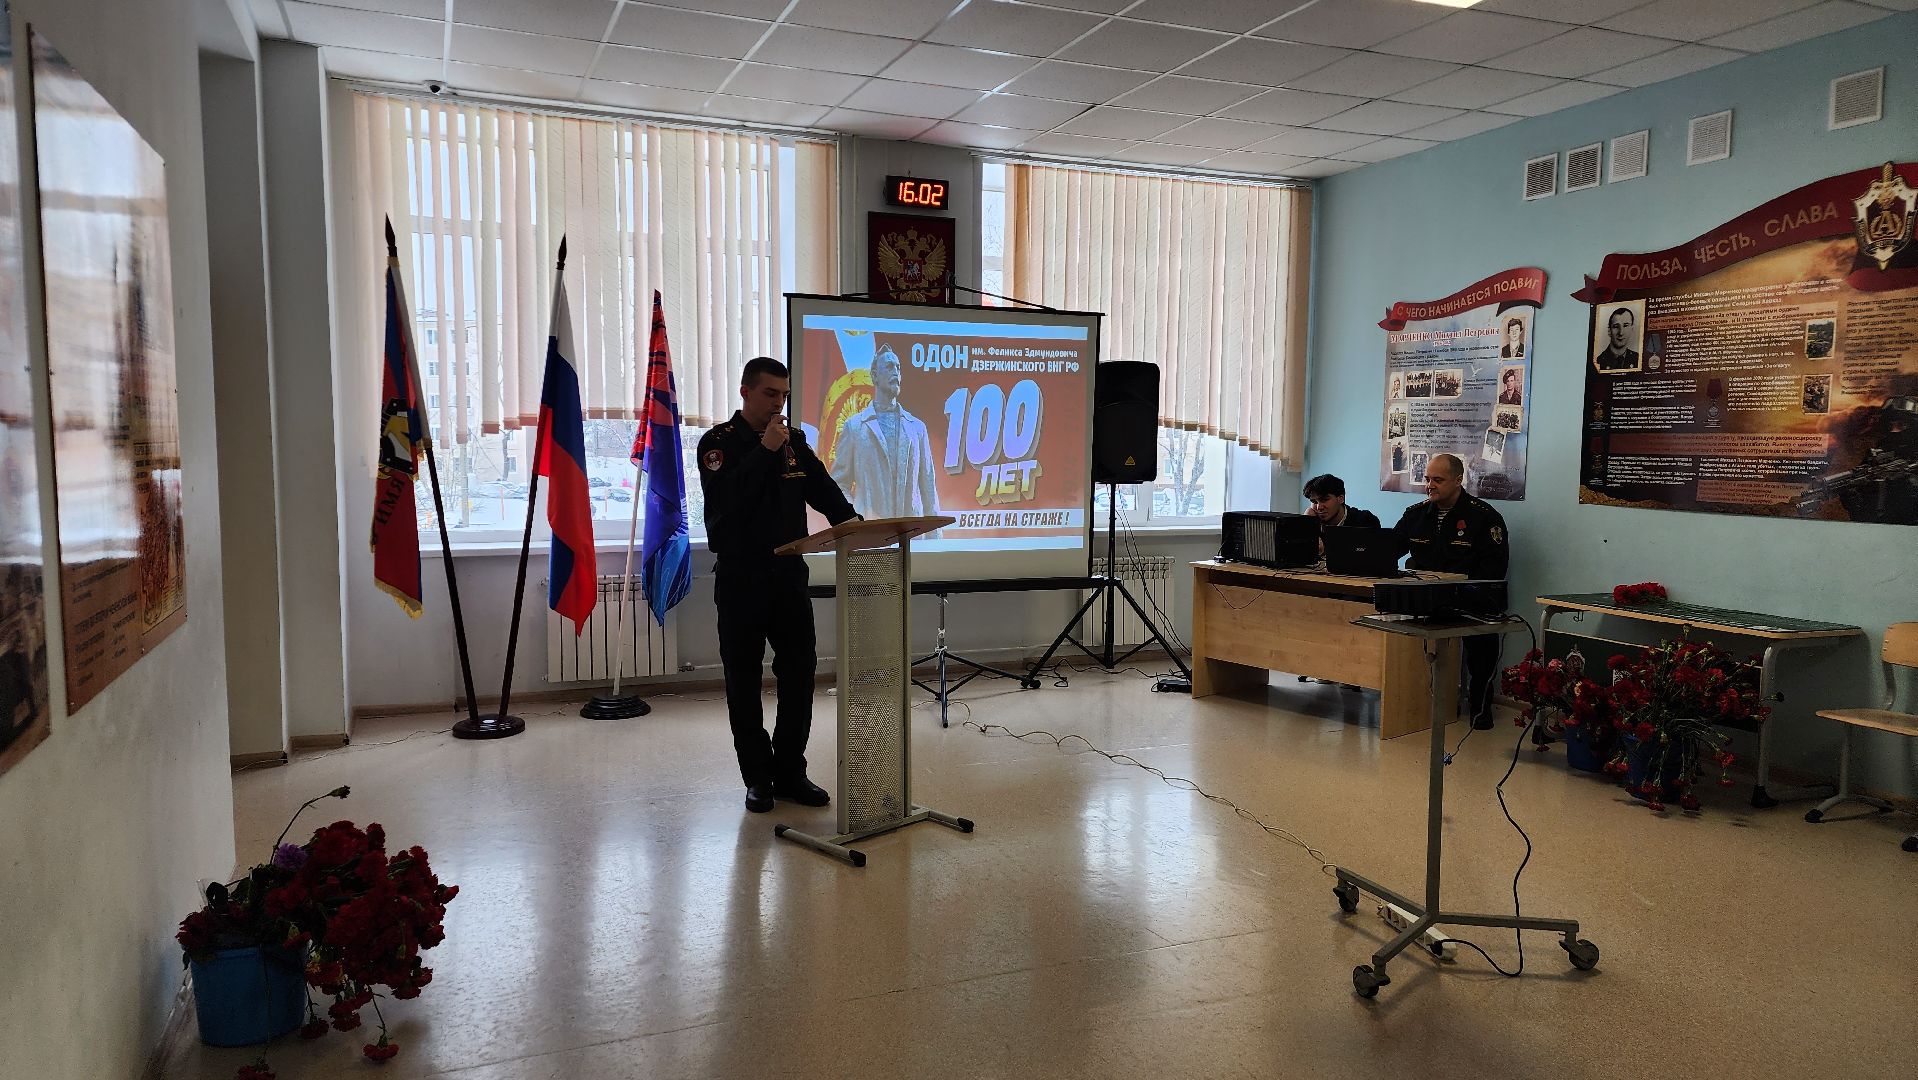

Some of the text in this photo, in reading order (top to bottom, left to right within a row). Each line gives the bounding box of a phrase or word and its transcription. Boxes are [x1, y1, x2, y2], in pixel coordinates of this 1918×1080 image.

[899, 181, 943, 205] 16.02
[1616, 257, 1688, 281] ПОЛЬЗА,
[1694, 233, 1757, 264] ЧЕСТЬ,
[1763, 201, 1839, 237] СЛАВА
[1397, 277, 1540, 318] С ЧЕГО НАЧИНАЕТСЯ ПОДВИГ
[911, 343, 968, 372] ОДОН
[971, 347, 986, 356] им.
[988, 346, 1023, 357] Феликса
[971, 359, 1080, 373] ДЗЕРЖИНСКОГО ВНГ РФ
[944, 379, 1043, 472] 100
[976, 460, 1042, 503] ЛЕТ
[959, 513, 1001, 528] ВСЕГДА
[1004, 512, 1018, 527] НА
